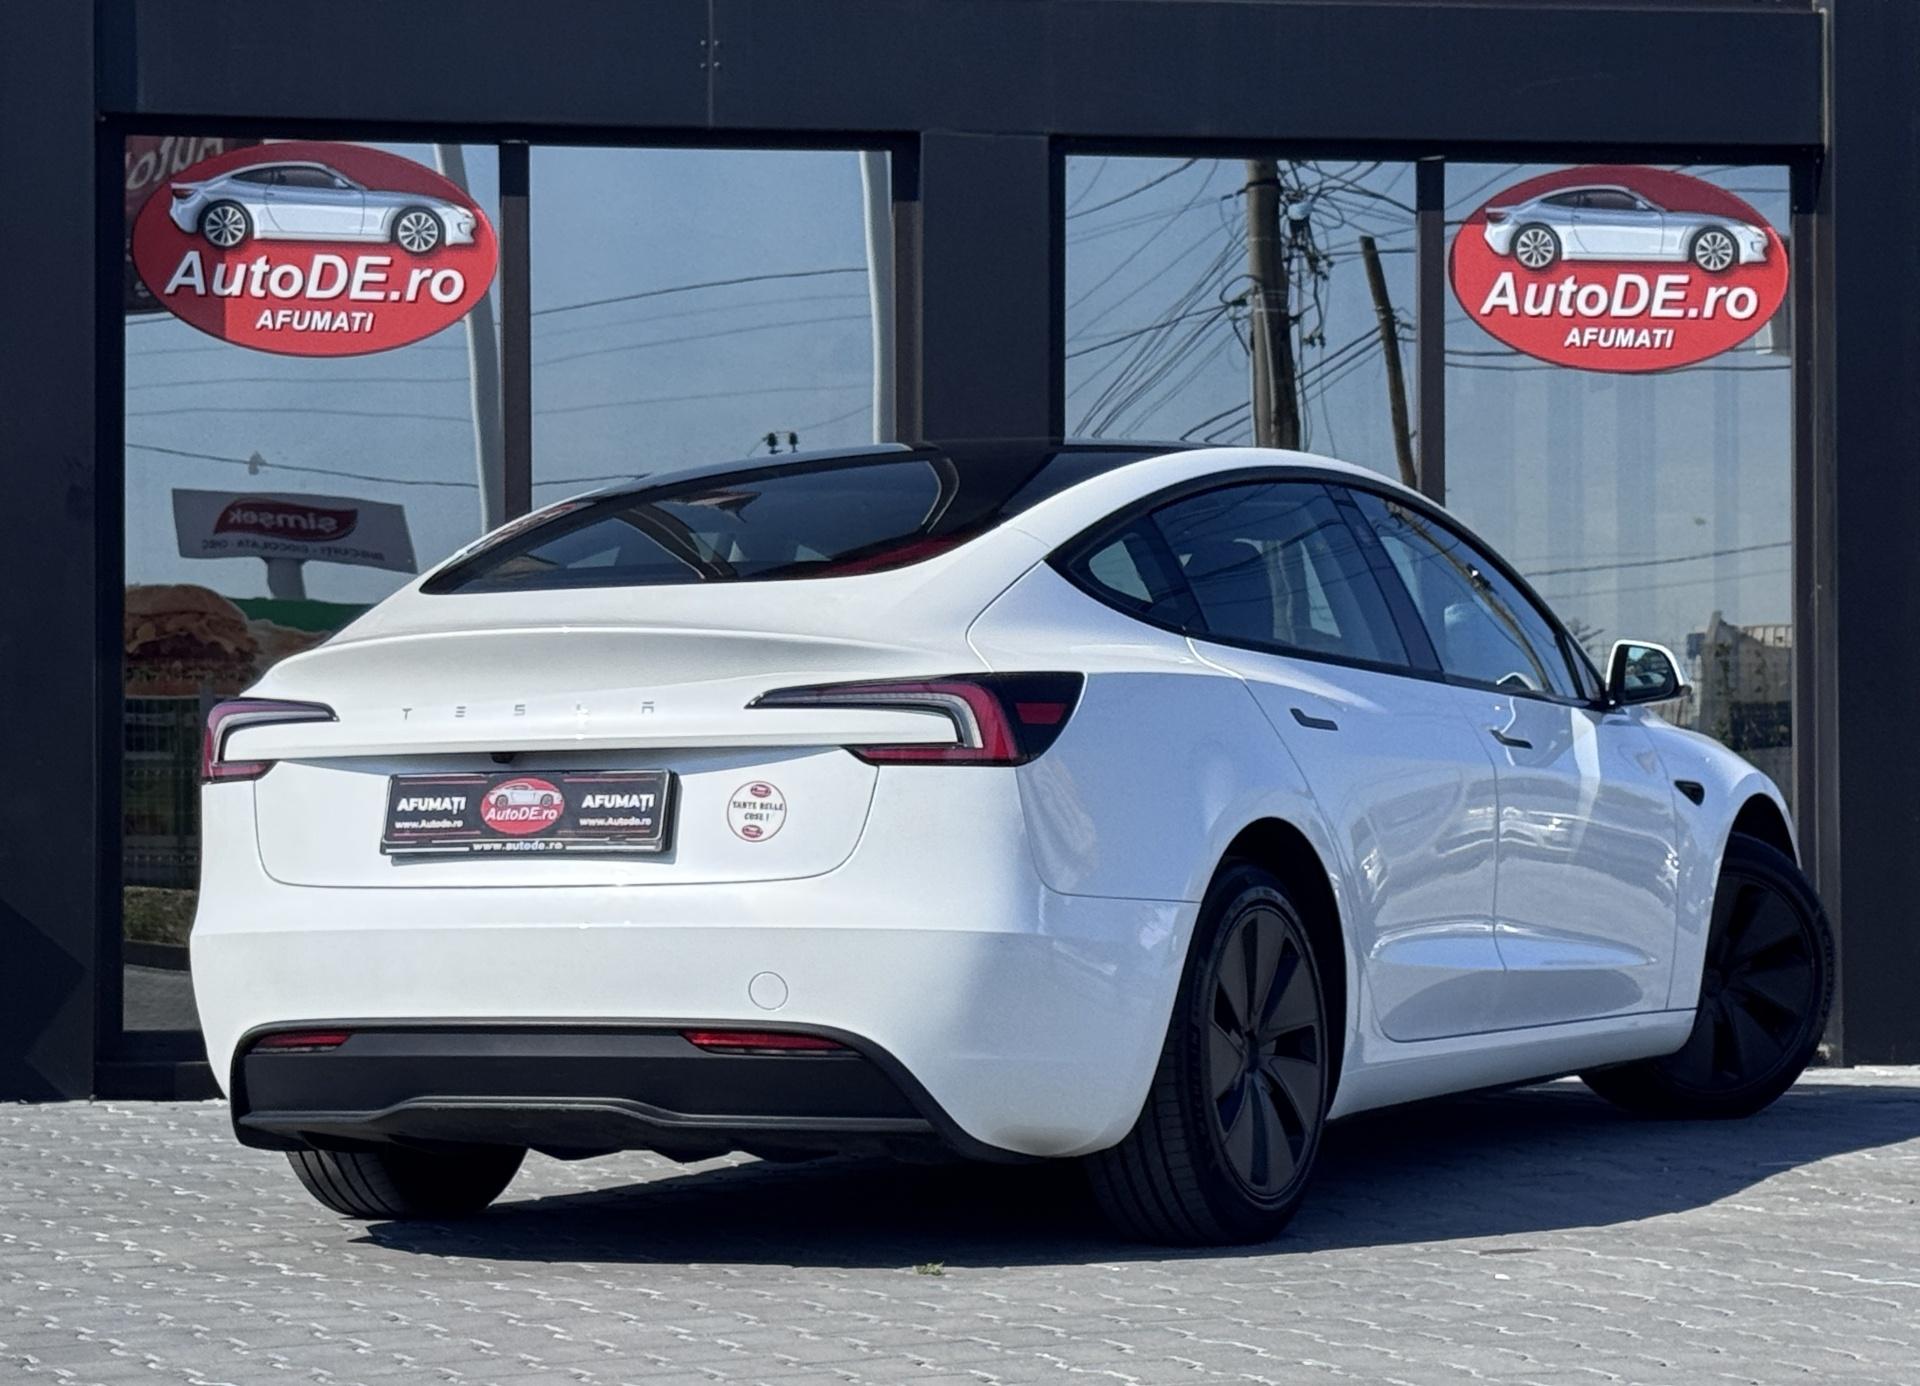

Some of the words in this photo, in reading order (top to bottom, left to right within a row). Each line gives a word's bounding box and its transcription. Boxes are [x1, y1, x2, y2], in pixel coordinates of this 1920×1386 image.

[164, 251, 465, 302] AutoDE.ro
[1480, 272, 1758, 320] AutoDE.ro
[256, 310, 374, 332] AFUMATI
[1564, 328, 1674, 348] AFUMATI
[484, 806, 559, 821] AutoDE.ro
[472, 841, 564, 851] www.autode.ro
